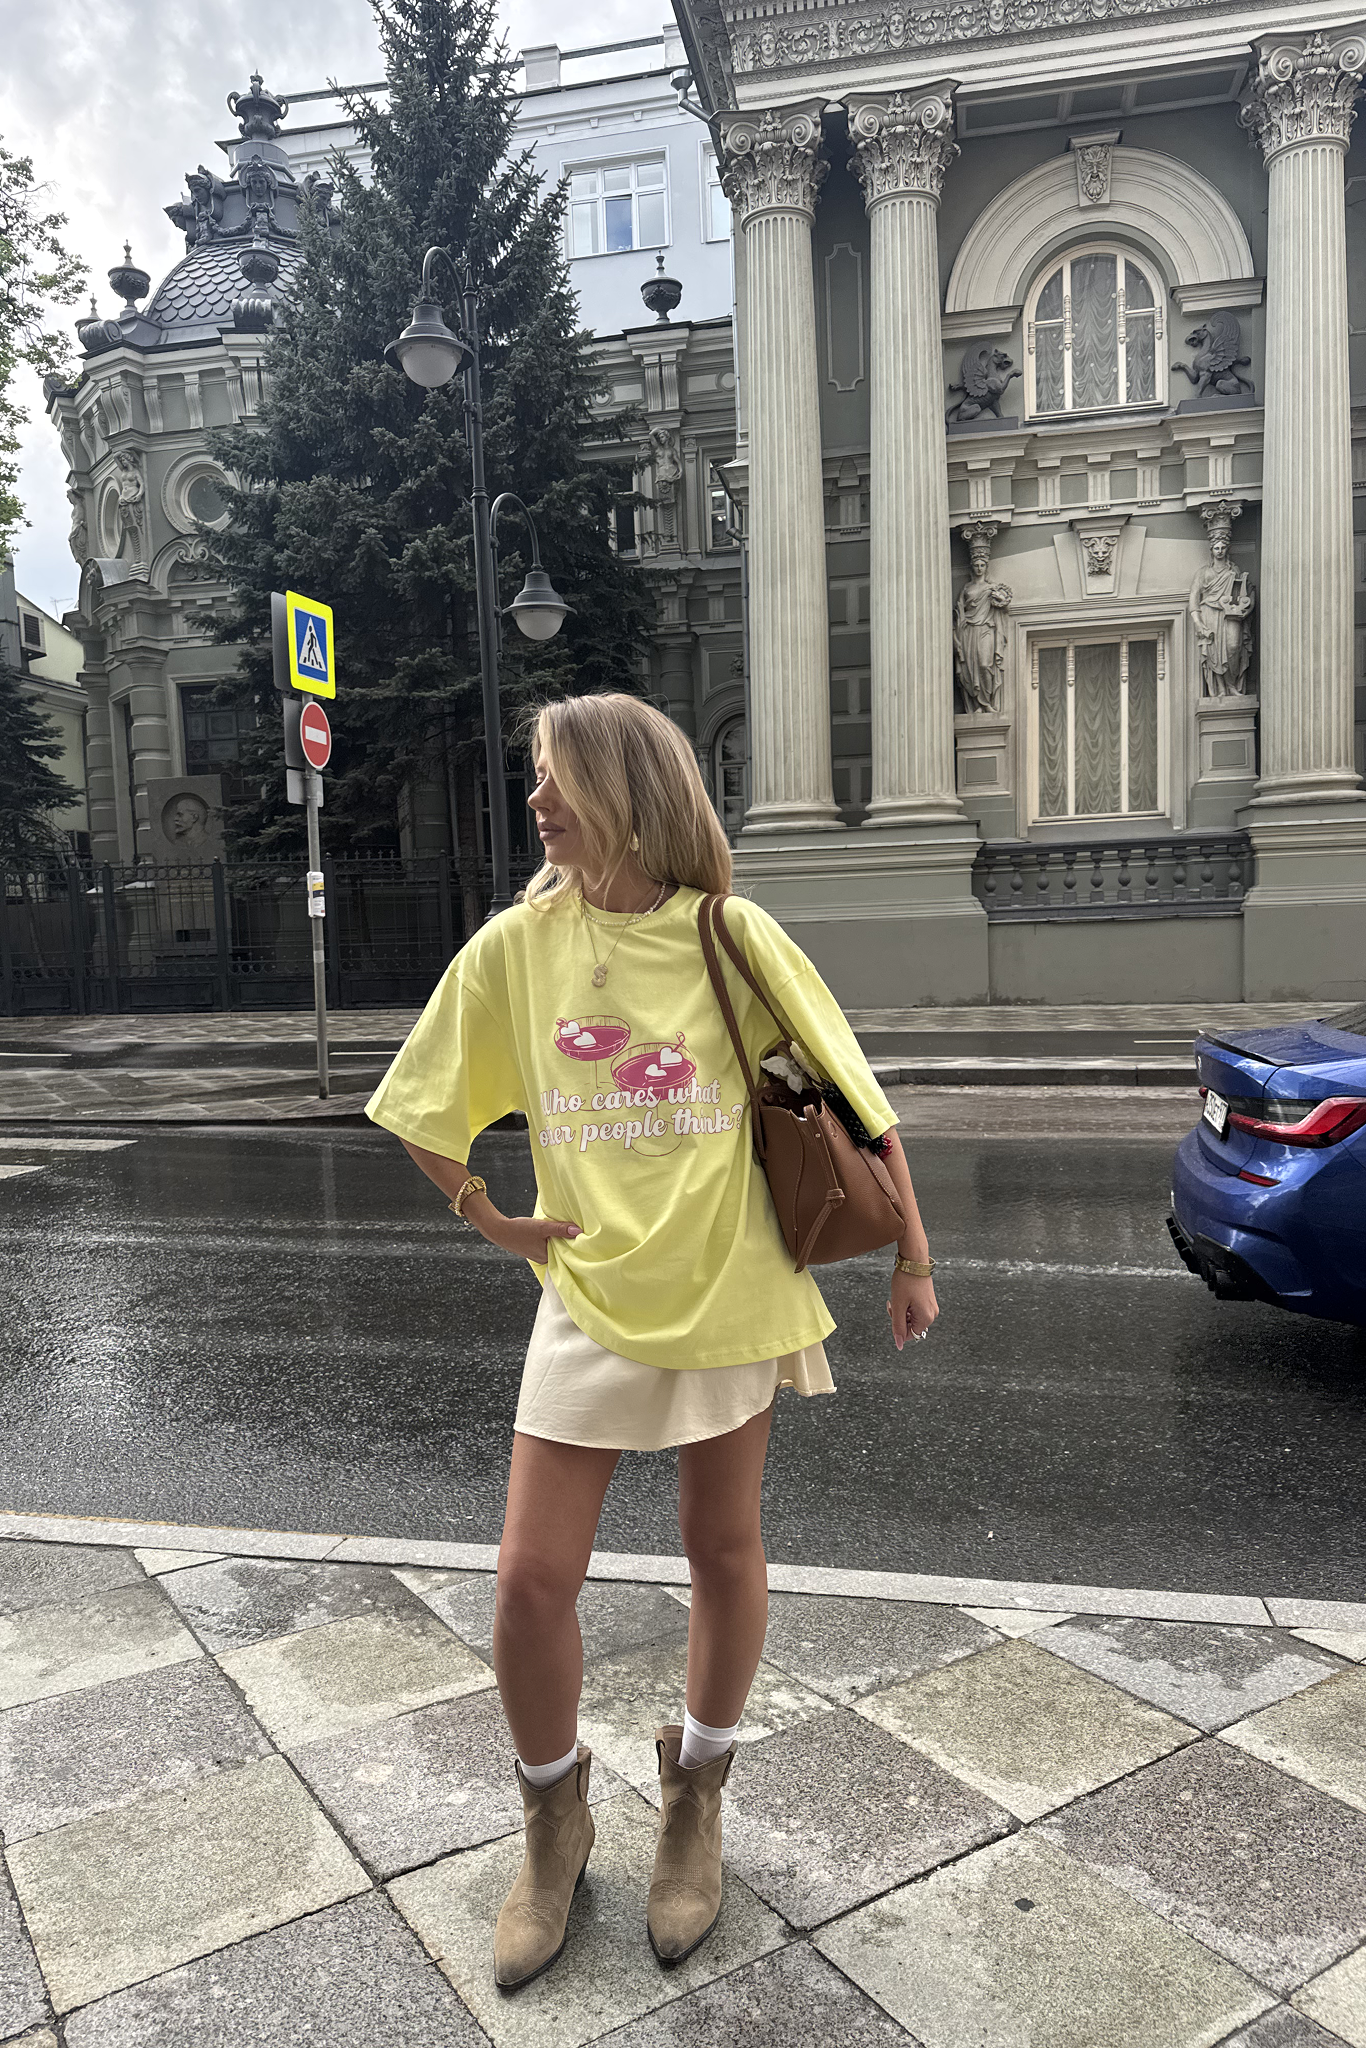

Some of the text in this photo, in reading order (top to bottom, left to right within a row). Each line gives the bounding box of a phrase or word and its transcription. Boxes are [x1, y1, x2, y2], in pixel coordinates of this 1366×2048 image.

[540, 1077, 721, 1116] Who cares what
[579, 1110, 668, 1152] people
[671, 1103, 744, 1135] think?
